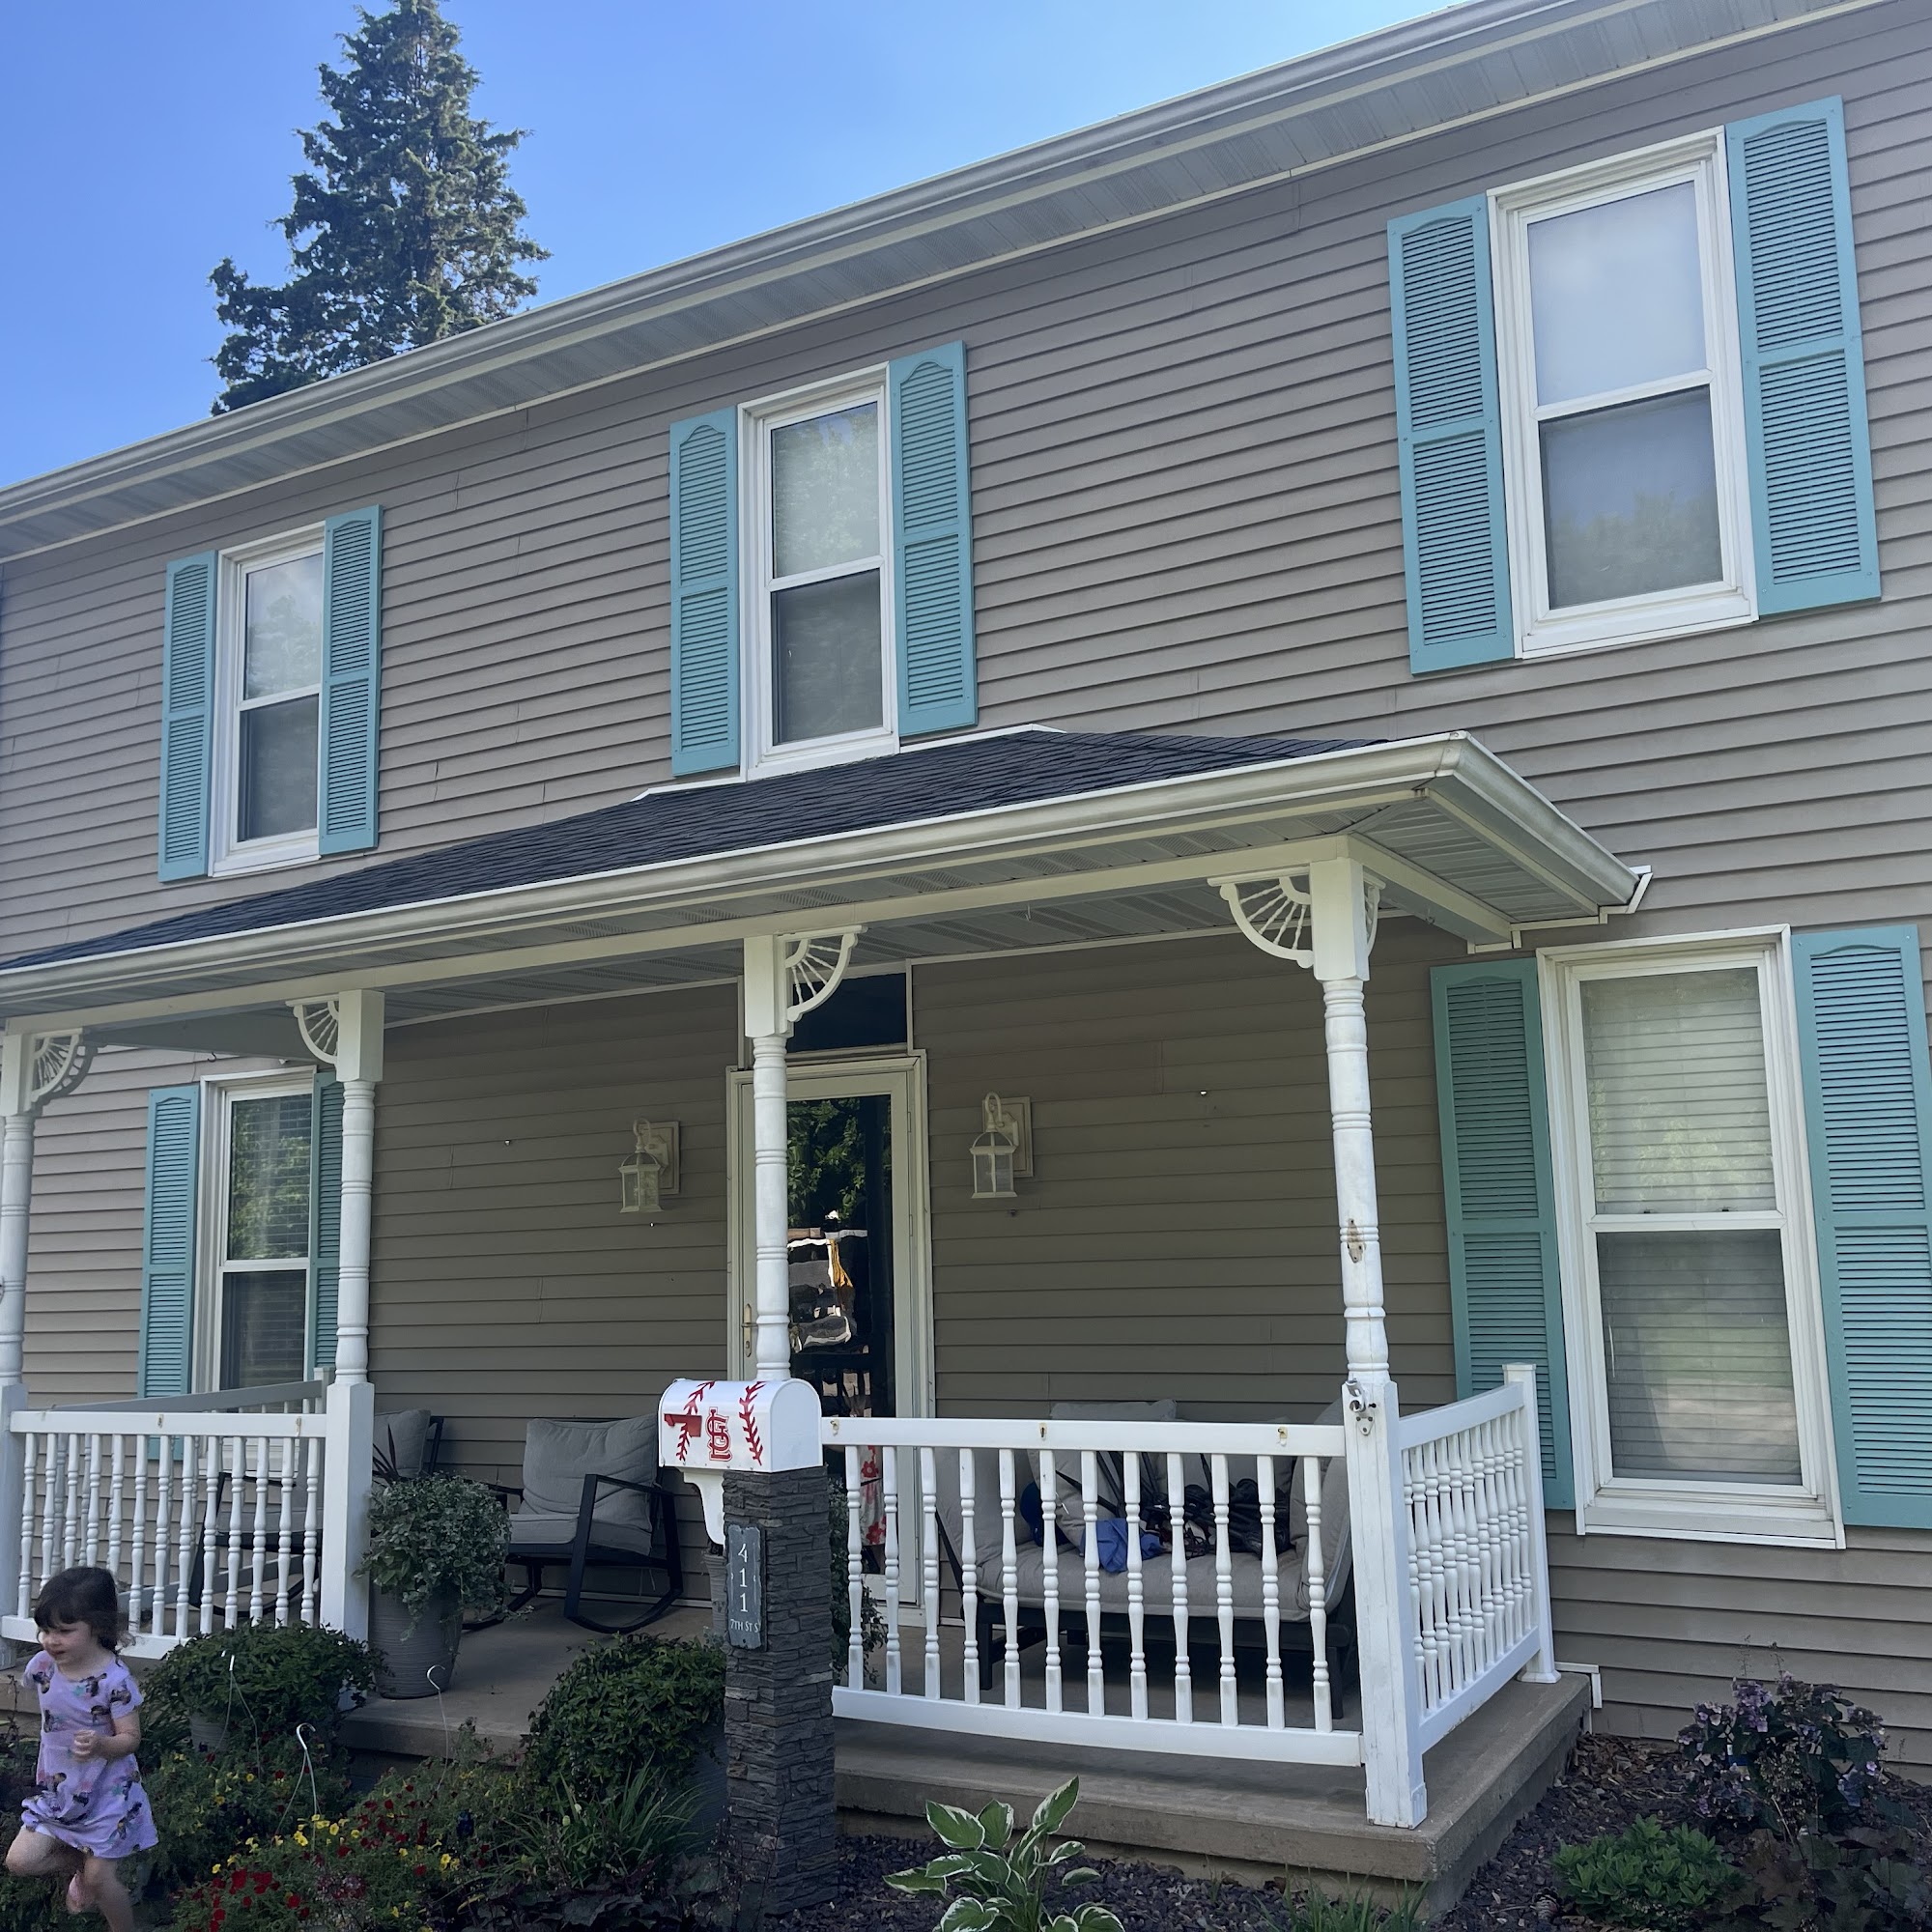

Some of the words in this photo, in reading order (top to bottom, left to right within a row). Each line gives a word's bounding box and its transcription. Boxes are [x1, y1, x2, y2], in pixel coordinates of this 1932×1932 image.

[738, 1543, 748, 1612] 411
[730, 1619, 743, 1631] 7TH
[745, 1621, 753, 1632] ST
